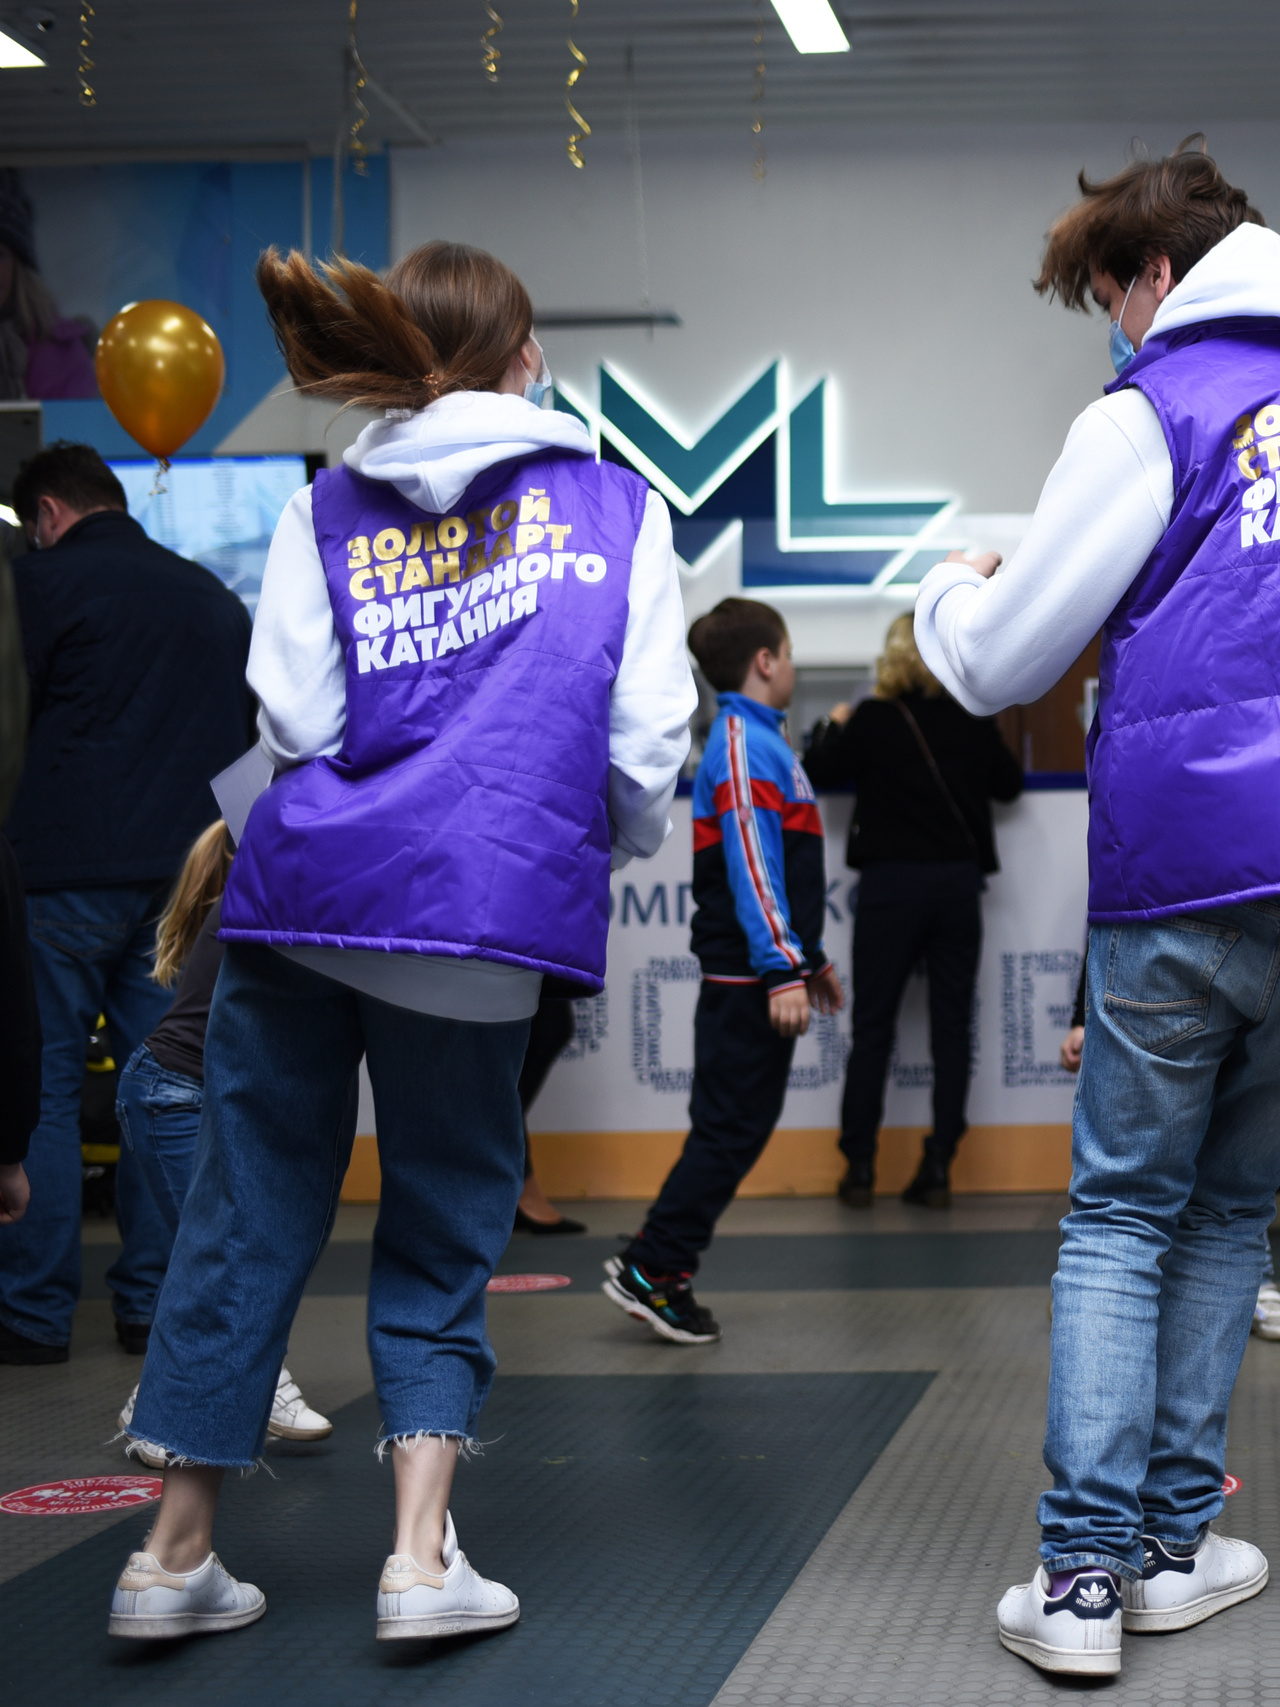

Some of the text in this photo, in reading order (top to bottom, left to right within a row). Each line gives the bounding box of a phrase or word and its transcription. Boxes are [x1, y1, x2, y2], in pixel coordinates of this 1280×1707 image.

[348, 487, 551, 569] ЗОЛОТОЙ
[349, 524, 572, 601] СТАНДАРТ
[352, 552, 607, 638] ФИГУРНОГО
[357, 583, 539, 675] КАТАНИЯ
[1075, 1597, 1112, 1609] stan smith
